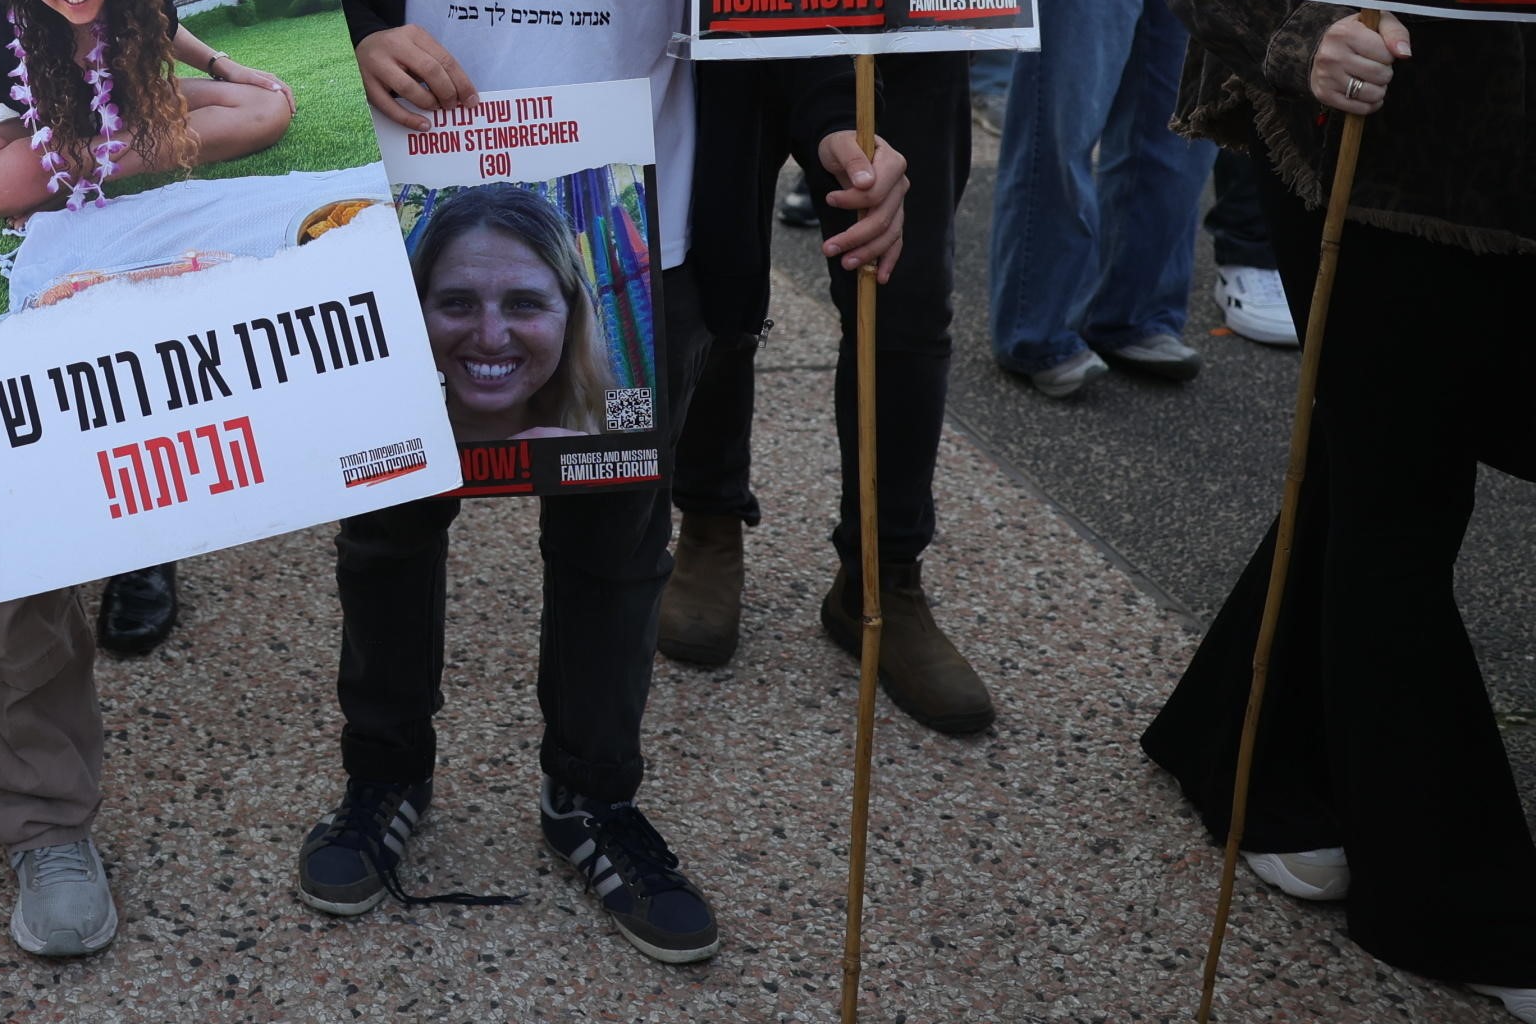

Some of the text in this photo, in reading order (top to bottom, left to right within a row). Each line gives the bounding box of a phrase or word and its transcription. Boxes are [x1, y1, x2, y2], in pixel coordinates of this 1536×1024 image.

[484, 3, 505, 27] לך
[511, 8, 564, 25] מחכים
[570, 10, 611, 26] אנחנו
[515, 96, 553, 123] דורון
[407, 121, 579, 155] DORON STEINBRECHER
[479, 151, 511, 179] (30)
[232, 291, 390, 390] החזירו
[155, 330, 233, 410] את
[47, 350, 153, 432] רומי
[97, 415, 265, 519] הביתה!
[340, 437, 423, 469] מטה המשפחות להחזרת
[343, 450, 427, 485] החטופים והנעדרים
[560, 449, 658, 466] HOSTAGES AND MISSING
[561, 459, 659, 482] FAMILIES FORUM
